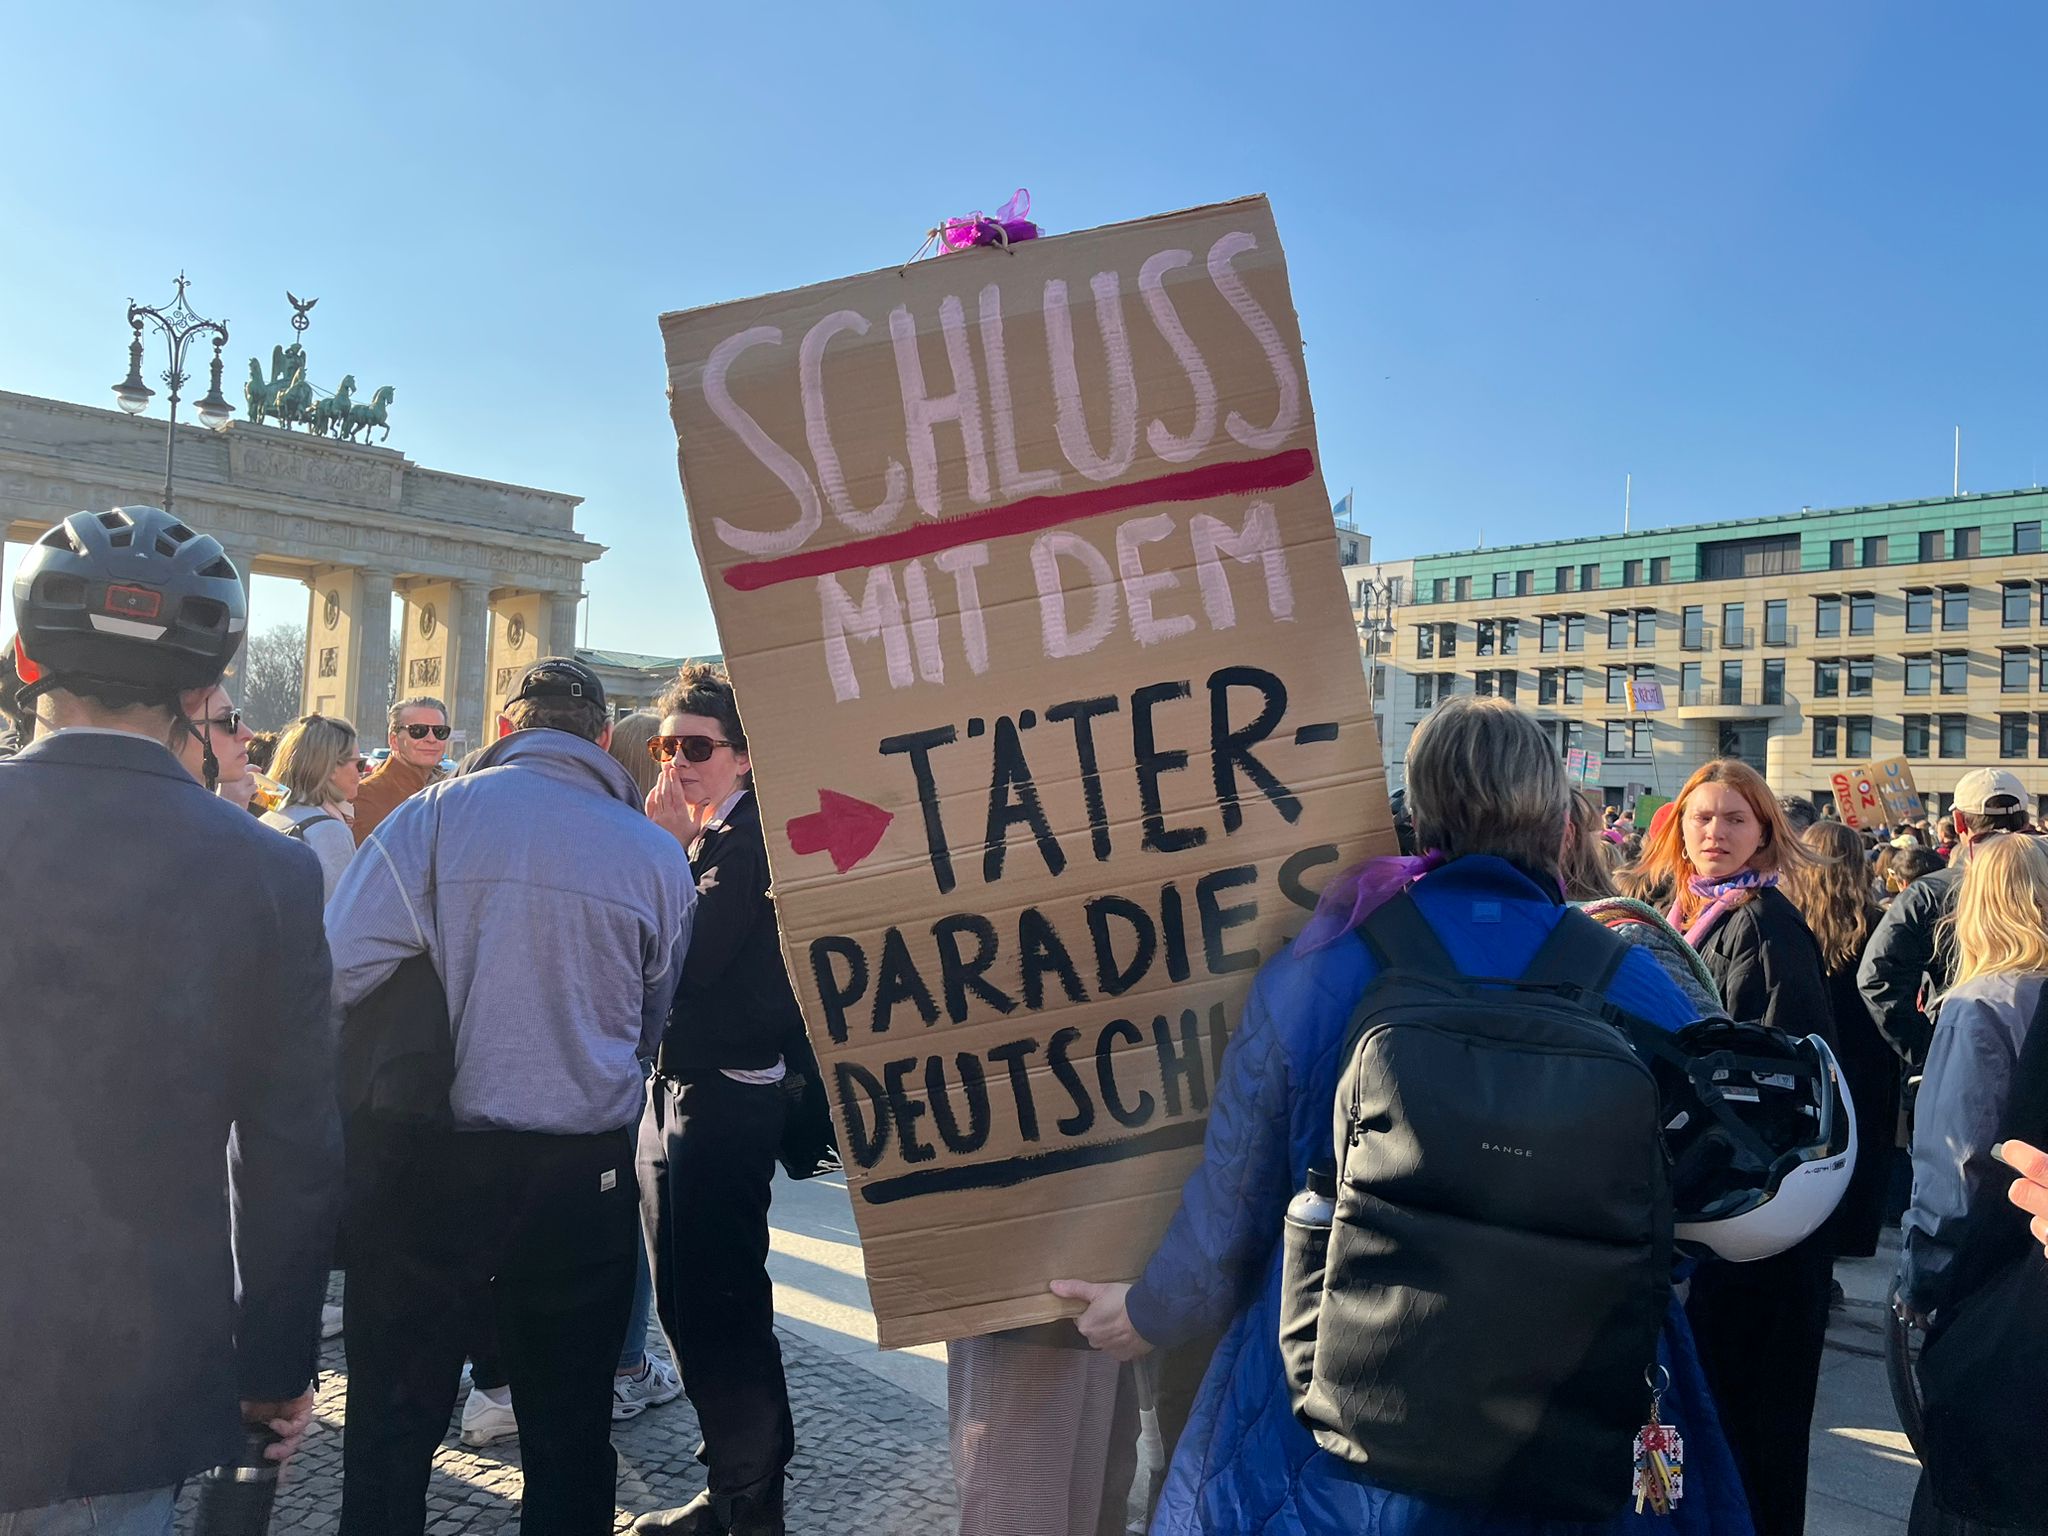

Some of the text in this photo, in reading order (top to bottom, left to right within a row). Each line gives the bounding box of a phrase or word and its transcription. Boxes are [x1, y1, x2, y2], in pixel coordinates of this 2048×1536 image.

[702, 231, 1300, 555] SCHLUSS
[817, 501, 1298, 703] MIT DEM
[879, 665, 1340, 895] TÄTER-
[1481, 1142, 1533, 1157] BANGE
